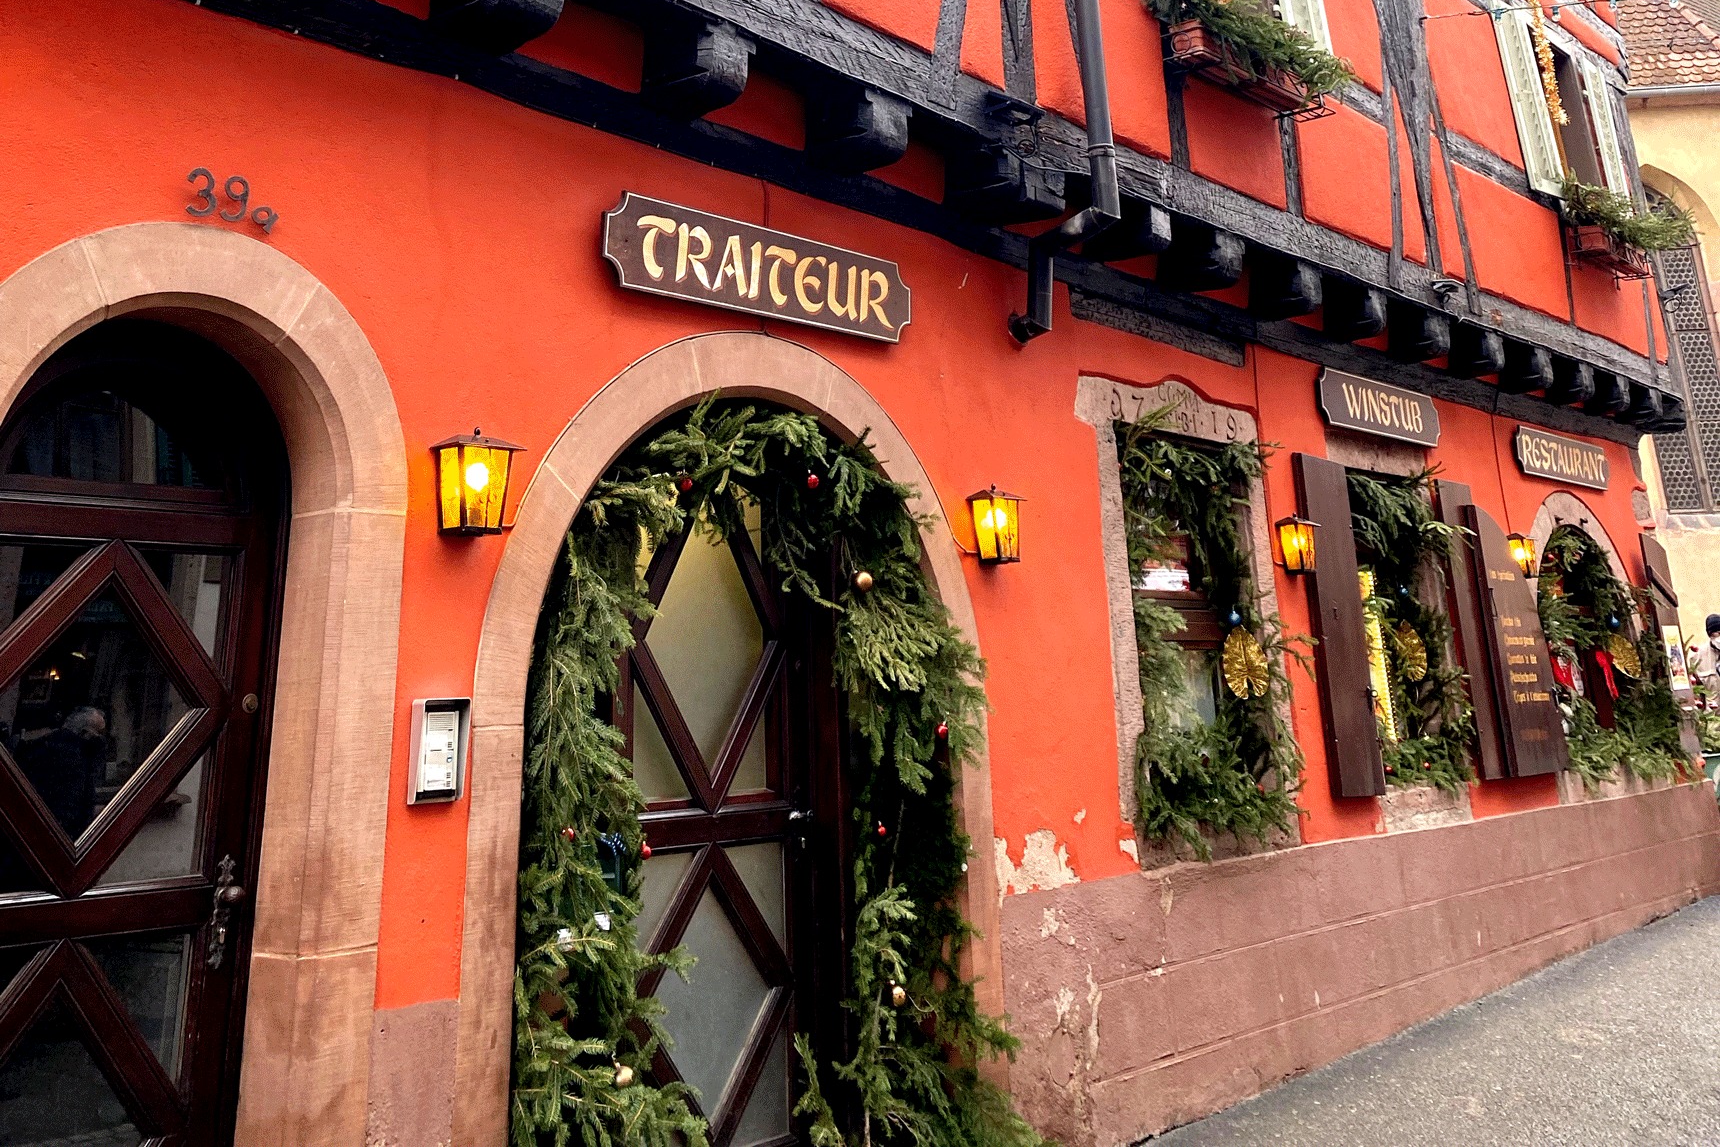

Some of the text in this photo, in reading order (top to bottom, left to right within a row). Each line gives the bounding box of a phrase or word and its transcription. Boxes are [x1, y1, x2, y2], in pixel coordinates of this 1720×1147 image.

[636, 215, 895, 331] TRAITEUR
[1342, 383, 1424, 434] WINSTUB
[1521, 433, 1606, 483] RESTAURANT
